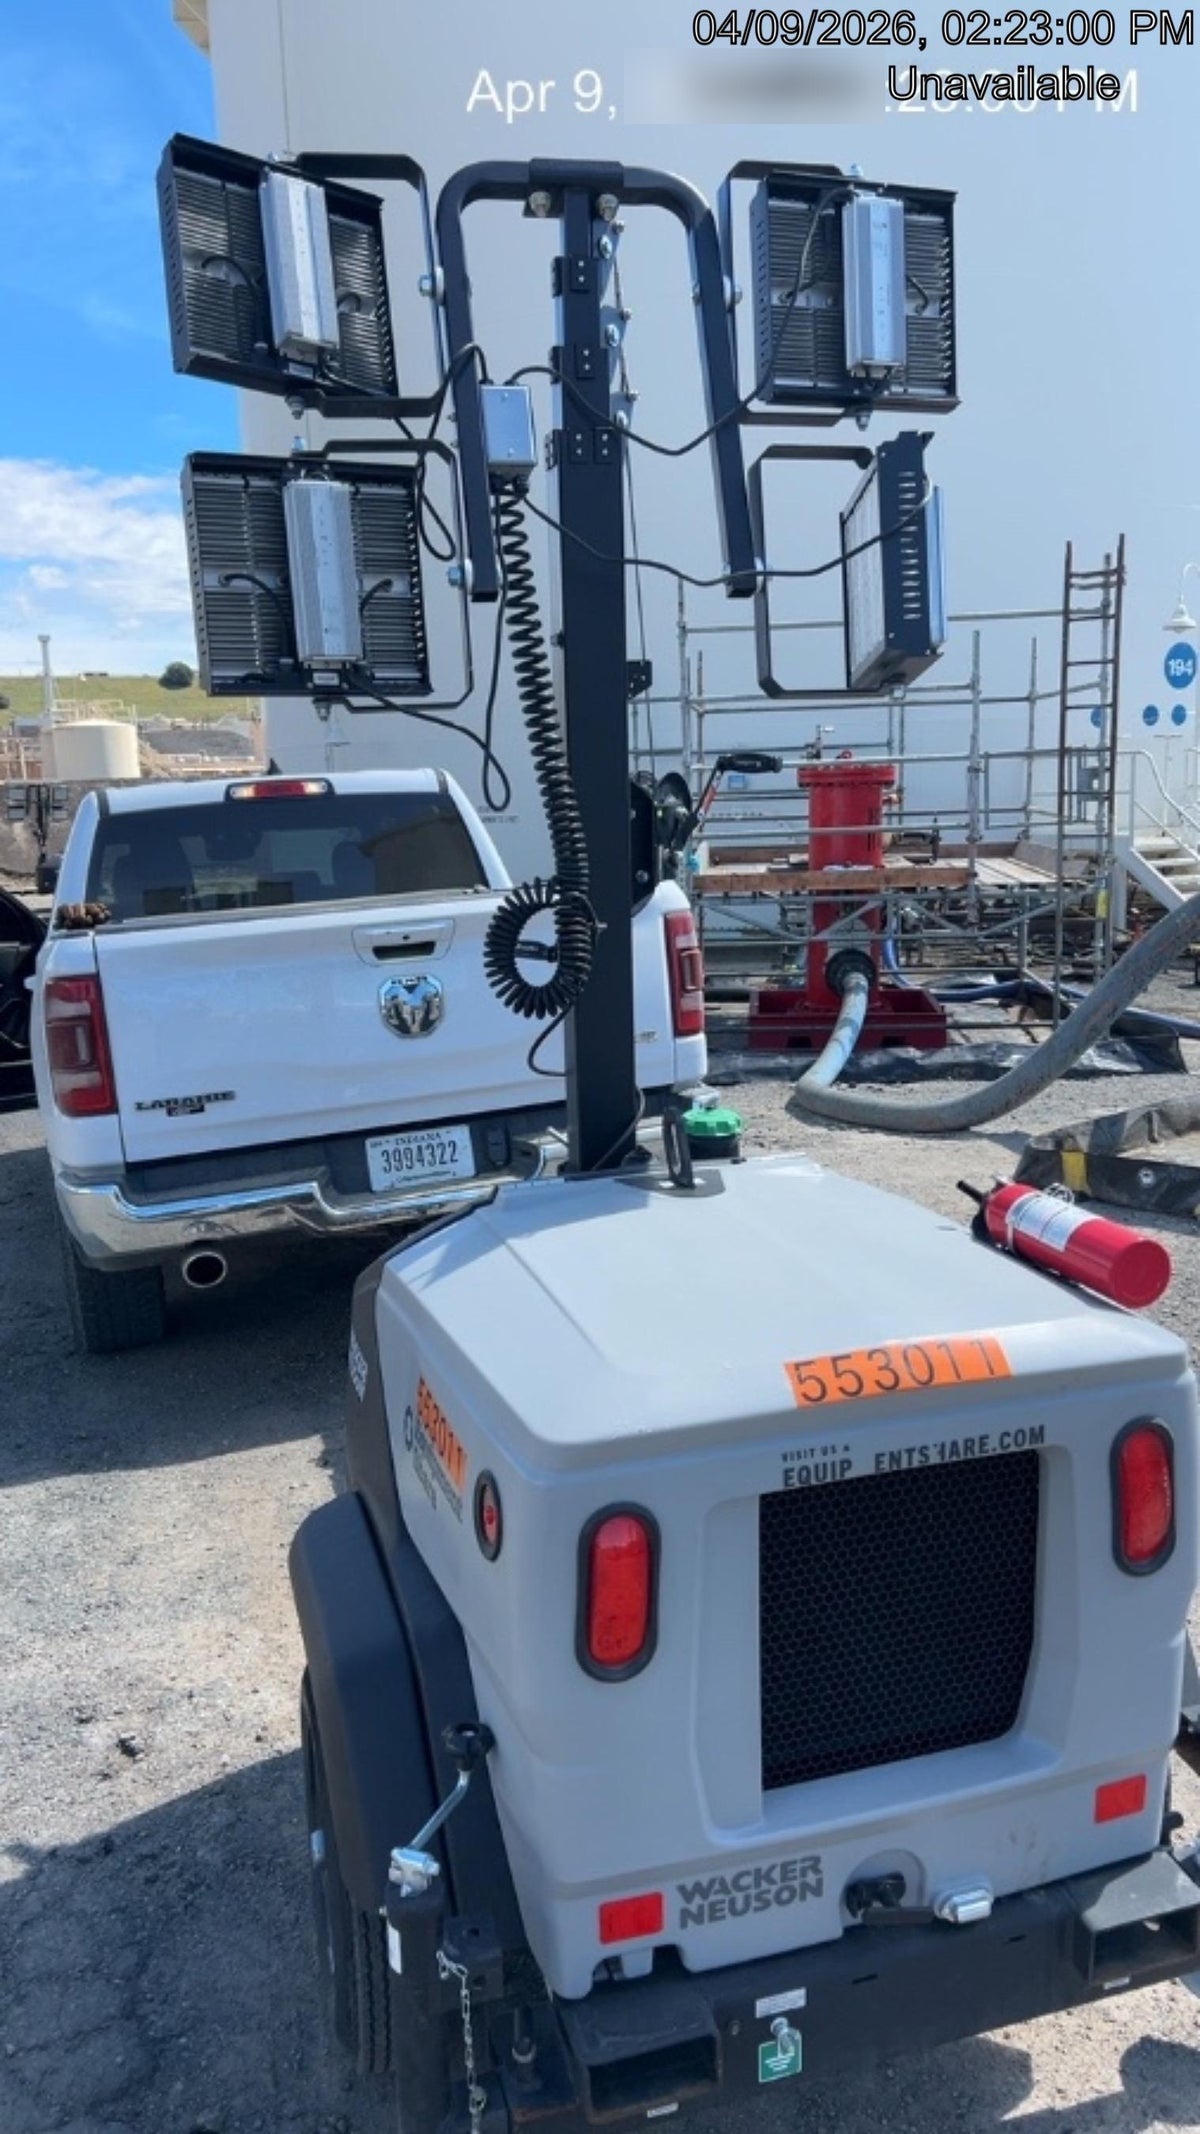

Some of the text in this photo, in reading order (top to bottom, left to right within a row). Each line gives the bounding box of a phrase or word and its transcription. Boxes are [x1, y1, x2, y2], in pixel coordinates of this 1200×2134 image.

[1169, 658, 1194, 677] 194
[381, 1140, 459, 1174] 3994322
[793, 1338, 995, 1403] 553011
[781, 1448, 815, 1462] VISIT
[676, 1855, 823, 1905] WACKER
[679, 1876, 824, 1930] NEUSON
